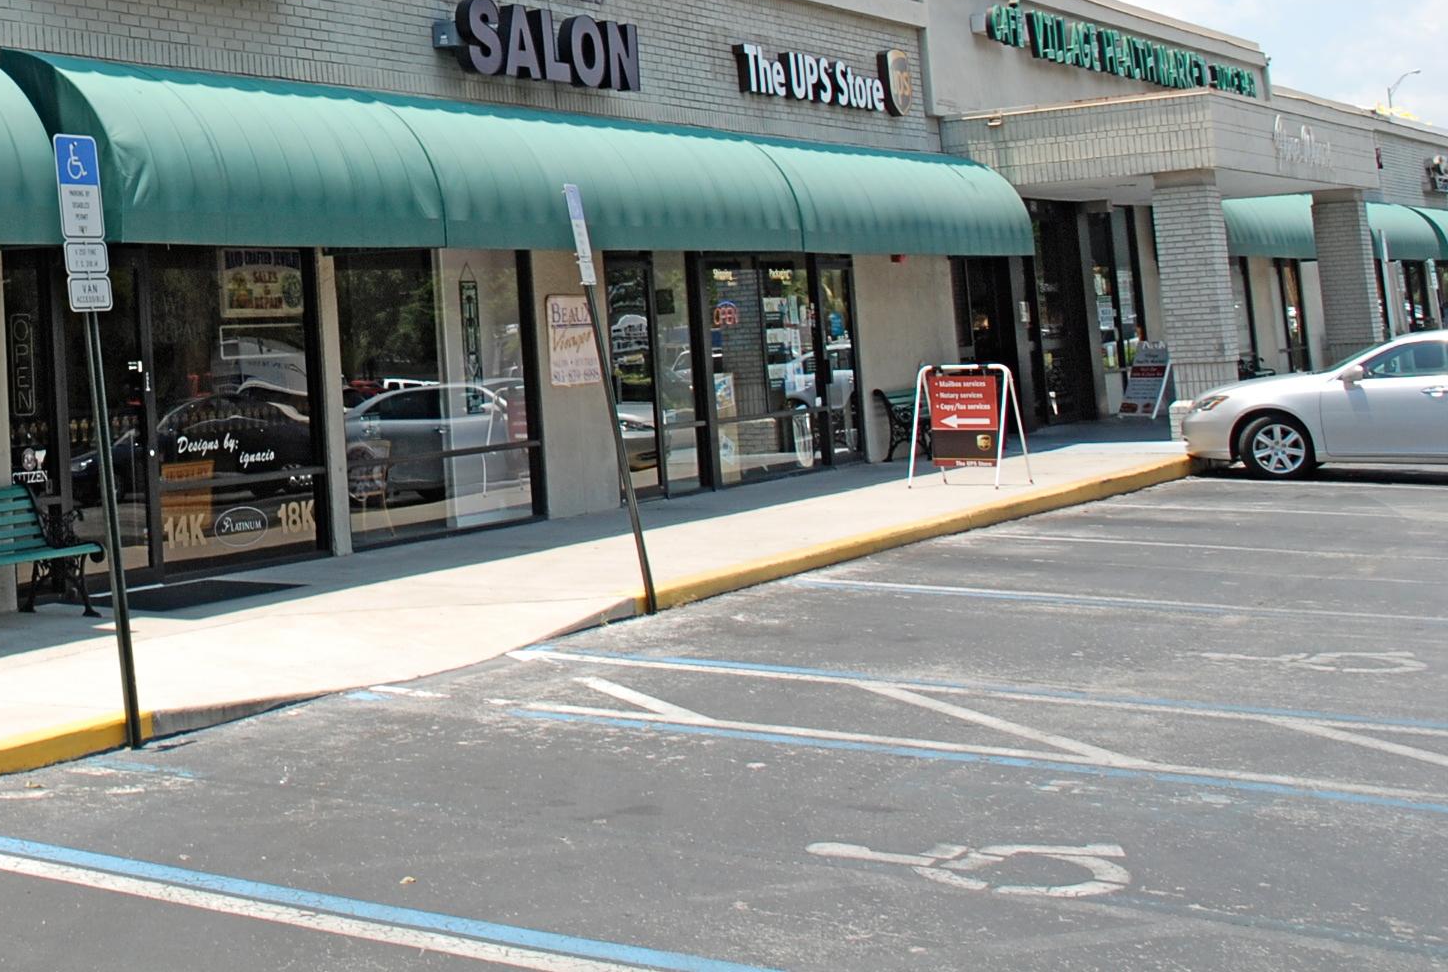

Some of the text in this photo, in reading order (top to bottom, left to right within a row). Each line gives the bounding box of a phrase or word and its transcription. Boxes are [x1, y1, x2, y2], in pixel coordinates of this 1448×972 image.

[1026, 9, 1208, 89] VILLAGE HEALTH MARKET
[734, 43, 886, 113] The UPS Store
[82, 284, 98, 294] VAN
[713, 307, 739, 325] OPEN
[13, 319, 33, 411] OPEN
[939, 392, 959, 400] Notary
[967, 402, 991, 410] services
[177, 432, 239, 456] Designs by:
[239, 449, 275, 468] ignacio
[12, 470, 49, 485] CITIZEN
[164, 512, 208, 549] 14K
[277, 499, 317, 535] 18K
